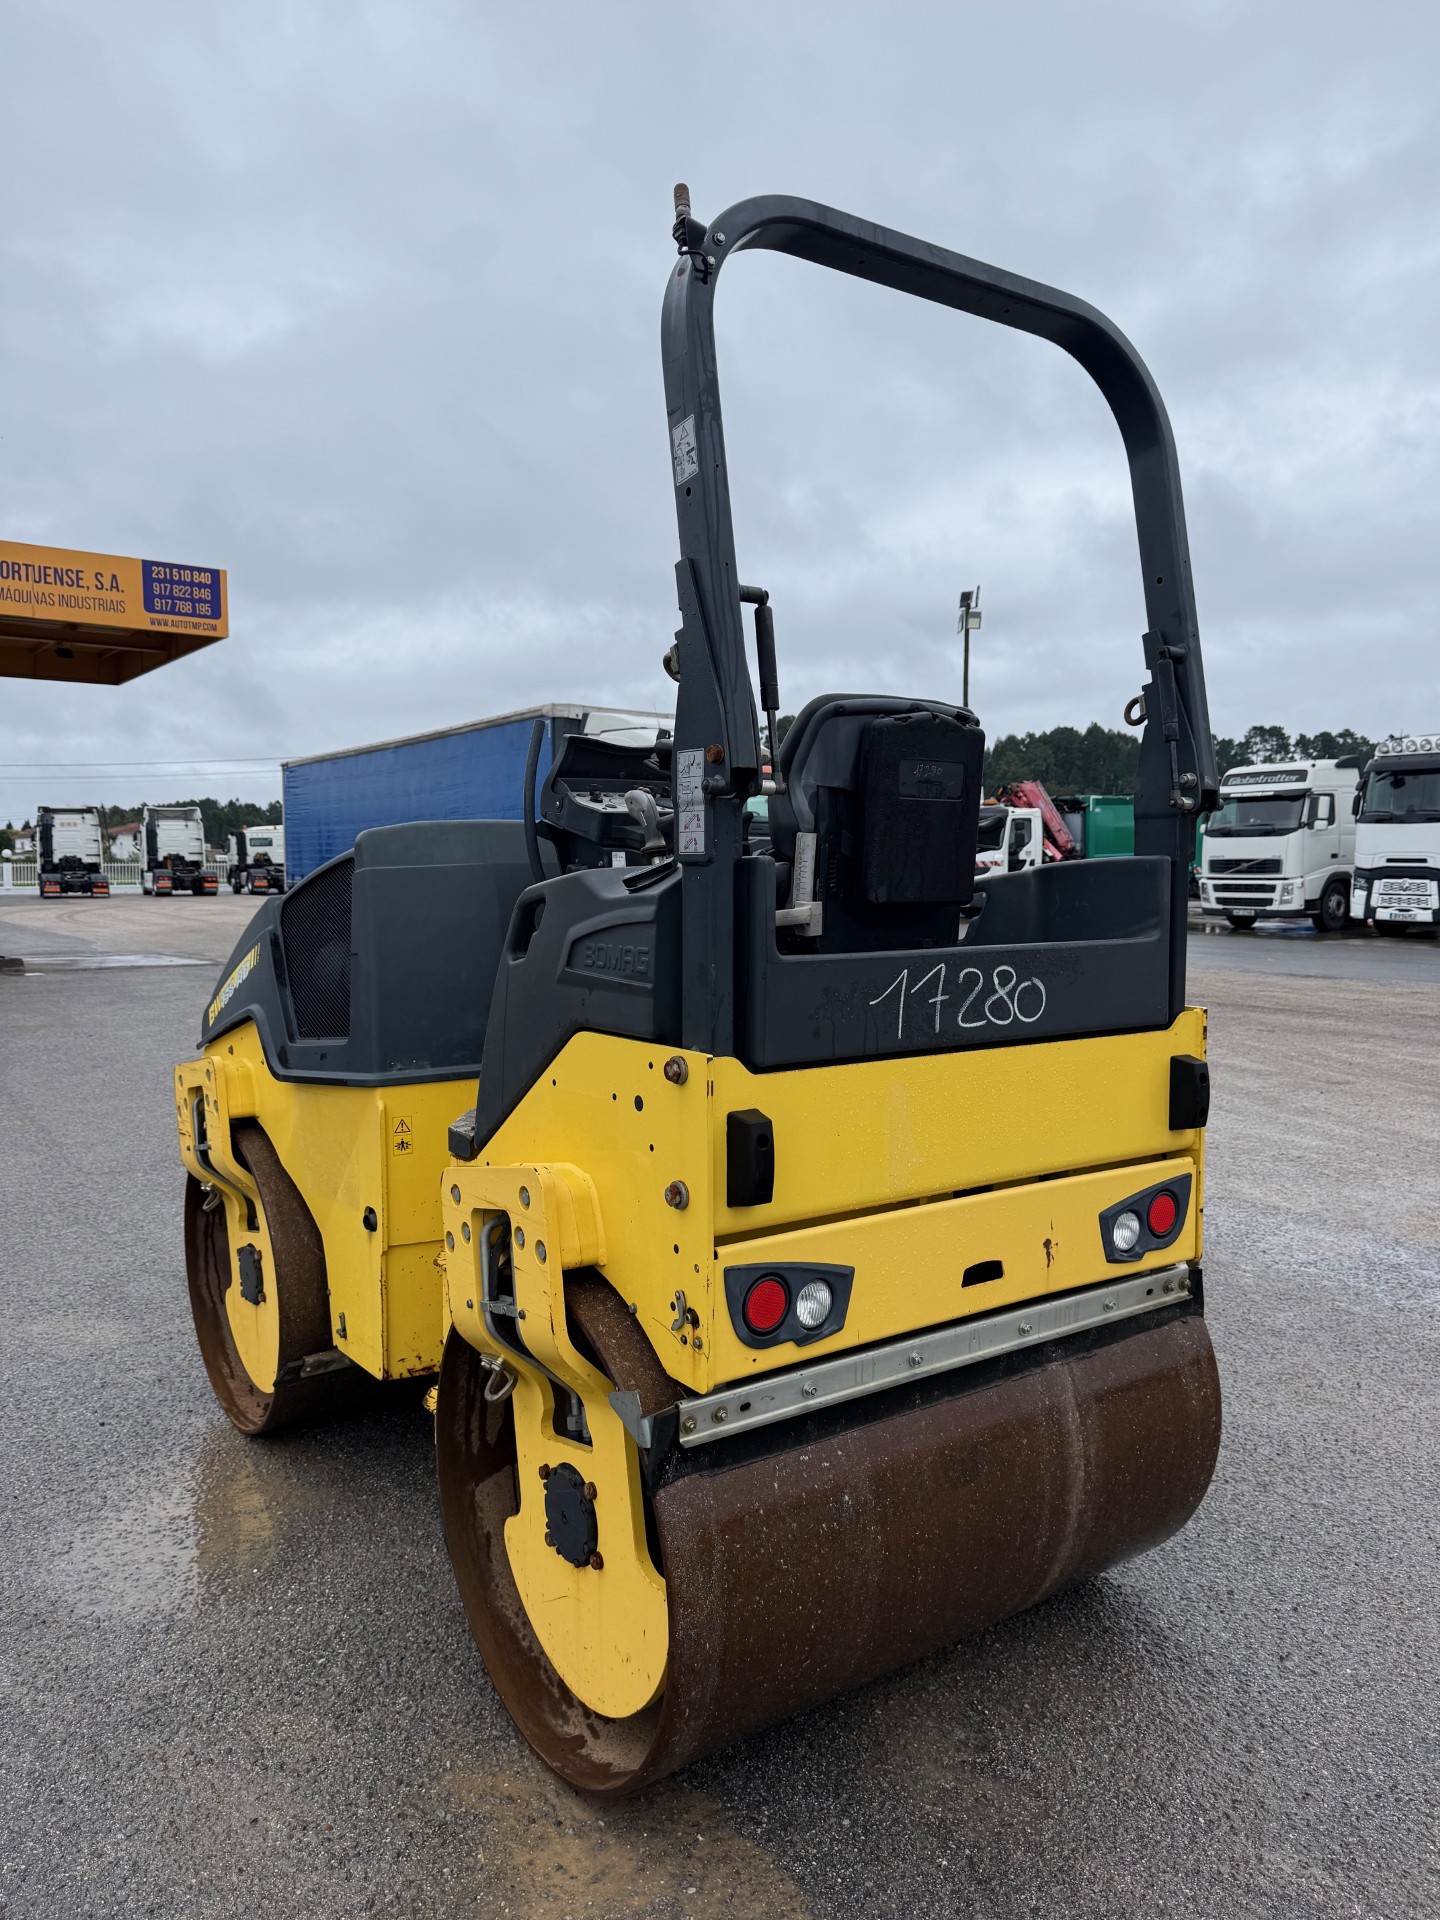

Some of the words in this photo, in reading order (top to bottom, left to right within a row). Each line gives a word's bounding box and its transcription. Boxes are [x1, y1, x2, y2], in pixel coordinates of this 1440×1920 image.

[0, 560, 90, 591] ORTUENSE,
[95, 571, 125, 592] S.A.
[151, 566, 171, 580] 231
[172, 568, 191, 582] 510
[193, 571, 211, 584] 840
[153, 582, 170, 596] 917
[173, 585, 191, 598] 822
[193, 587, 211, 601] 846
[58, 593, 126, 614] INDUSTRIAIS
[154, 598, 172, 611] 917
[174, 600, 192, 613] 768
[195, 603, 211, 616] 195
[149, 617, 217, 632] WWW.AUTOTMP.COM
[1228, 774, 1299, 786] Globetrotter
[584, 942, 649, 975] BOMAG
[868, 963, 1047, 1040] 17280
